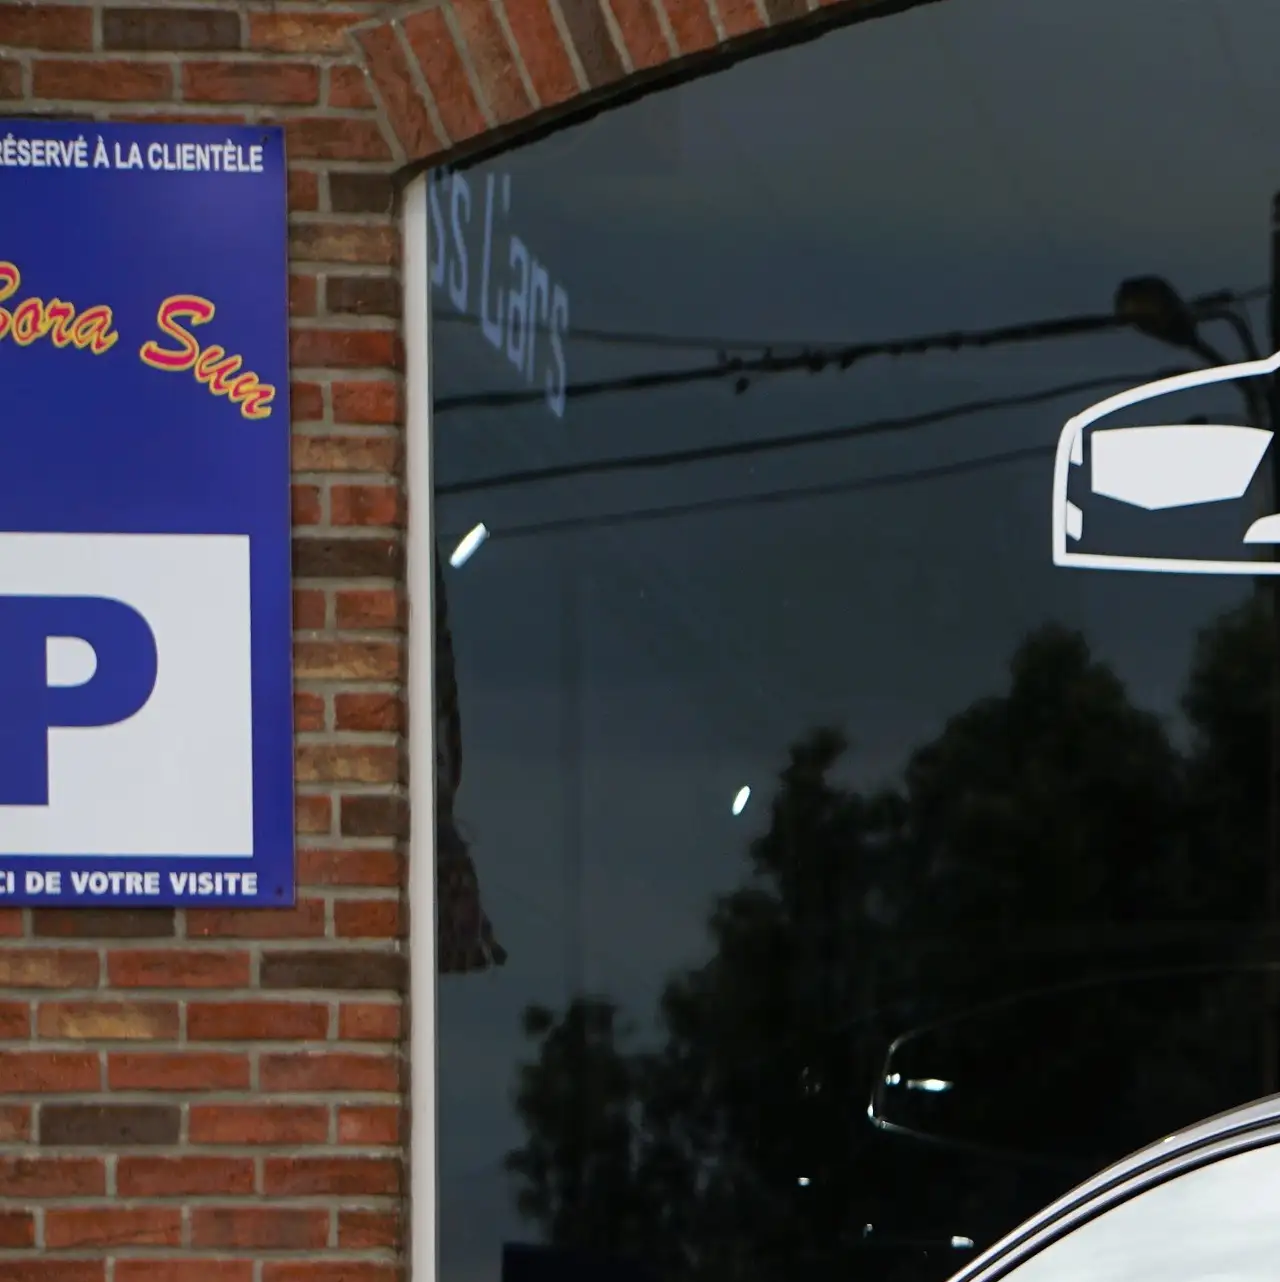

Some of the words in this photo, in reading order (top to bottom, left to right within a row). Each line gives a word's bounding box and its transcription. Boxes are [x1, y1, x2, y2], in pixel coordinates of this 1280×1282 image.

[0, 133, 88, 167] ÉSERVÉ
[94, 135, 110, 169] À
[114, 142, 144, 169] LA
[147, 139, 264, 172] CLIENTÈLE
[139, 294, 276, 419] Sun
[0, 594, 158, 806] P
[25, 871, 62, 895] DE
[70, 871, 160, 895] VOTRE
[169, 871, 258, 895] VISITE
